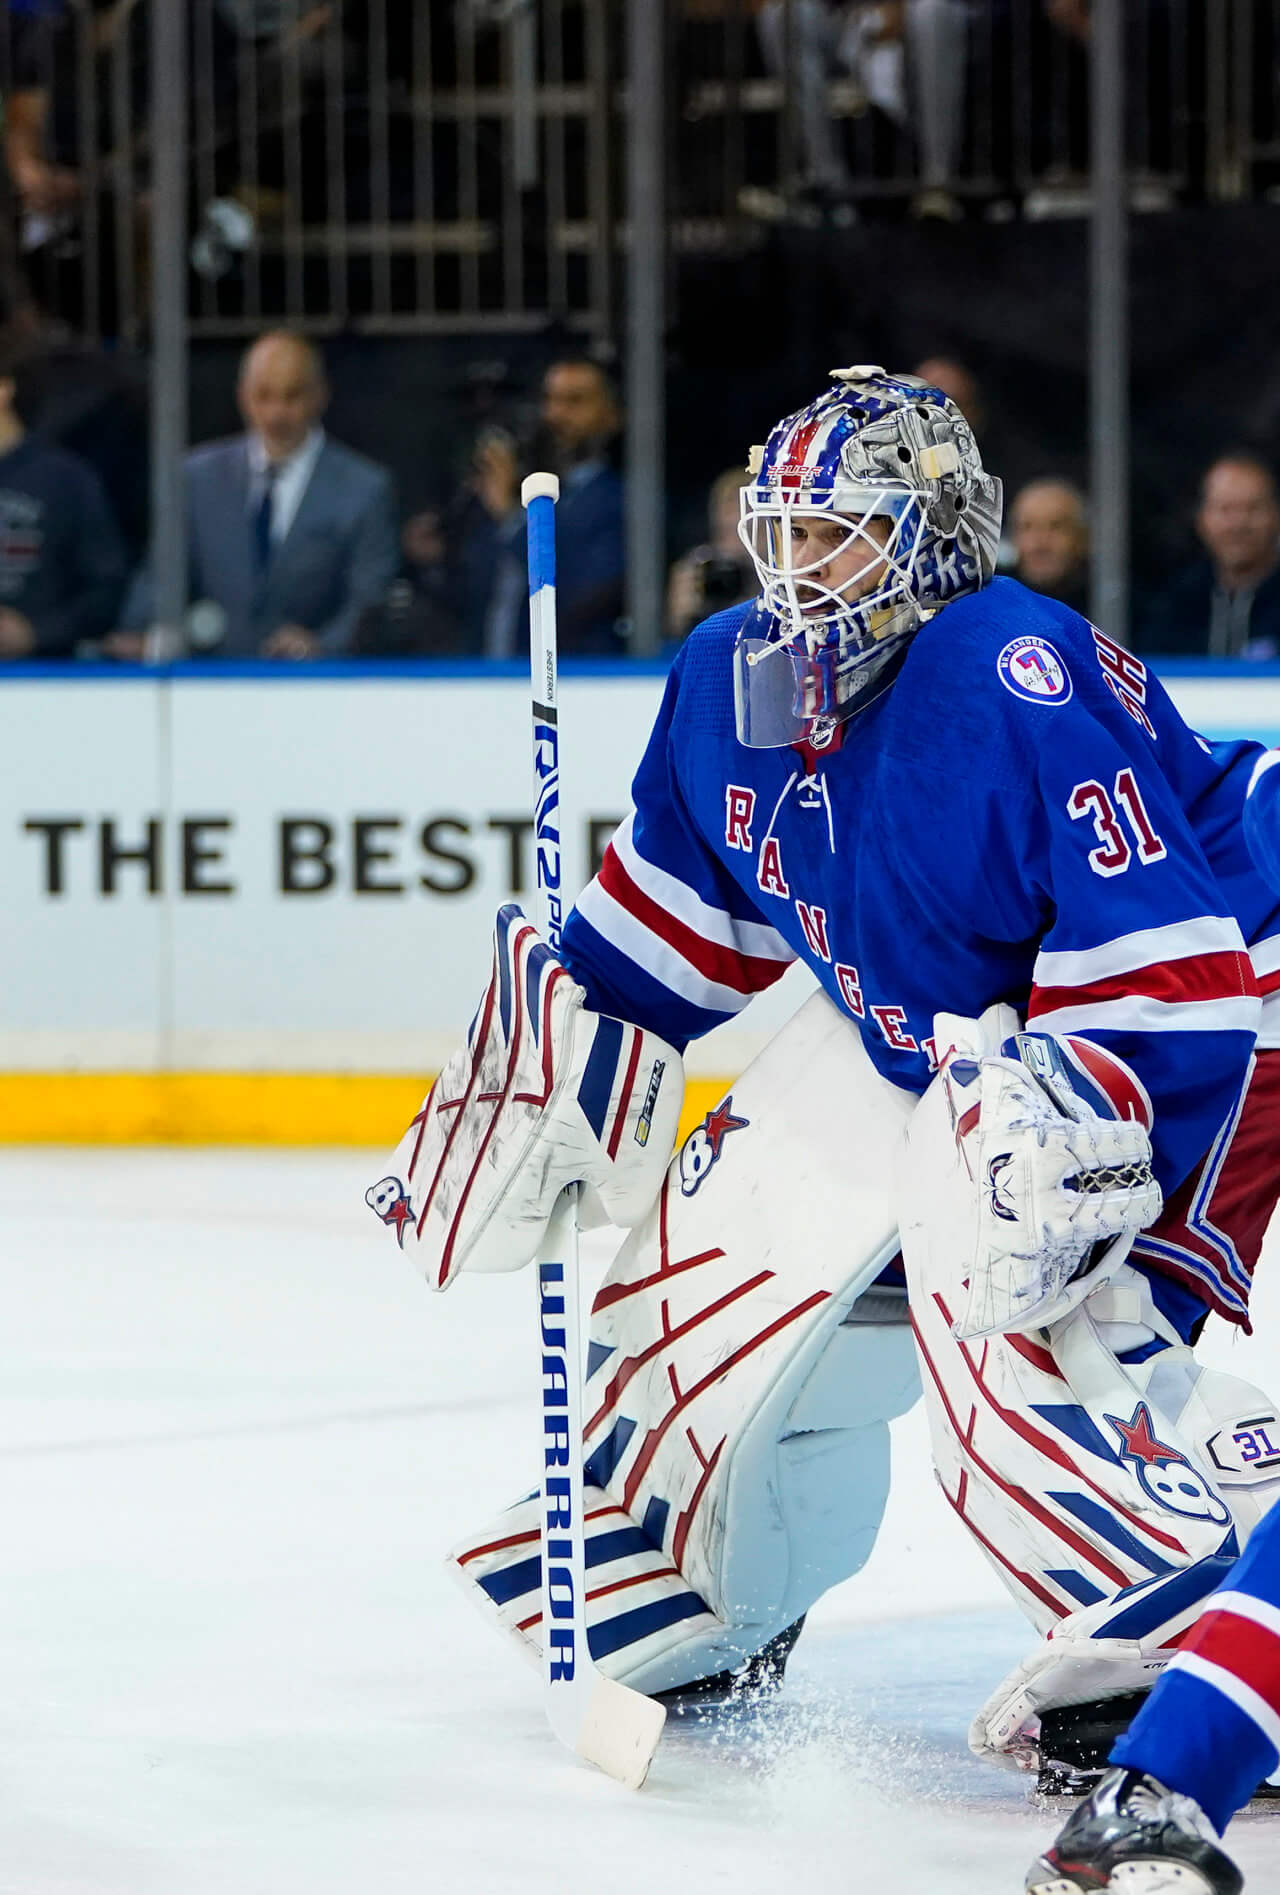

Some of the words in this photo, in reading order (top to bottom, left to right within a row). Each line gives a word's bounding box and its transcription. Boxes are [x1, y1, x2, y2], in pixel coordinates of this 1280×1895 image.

[766, 464, 824, 477] BAUER
[23, 817, 236, 896] THE
[277, 817, 537, 896] BEST
[1067, 767, 1168, 878] 31
[538, 1262, 577, 1687] WARRIOR
[1231, 1427, 1280, 1462] 31
